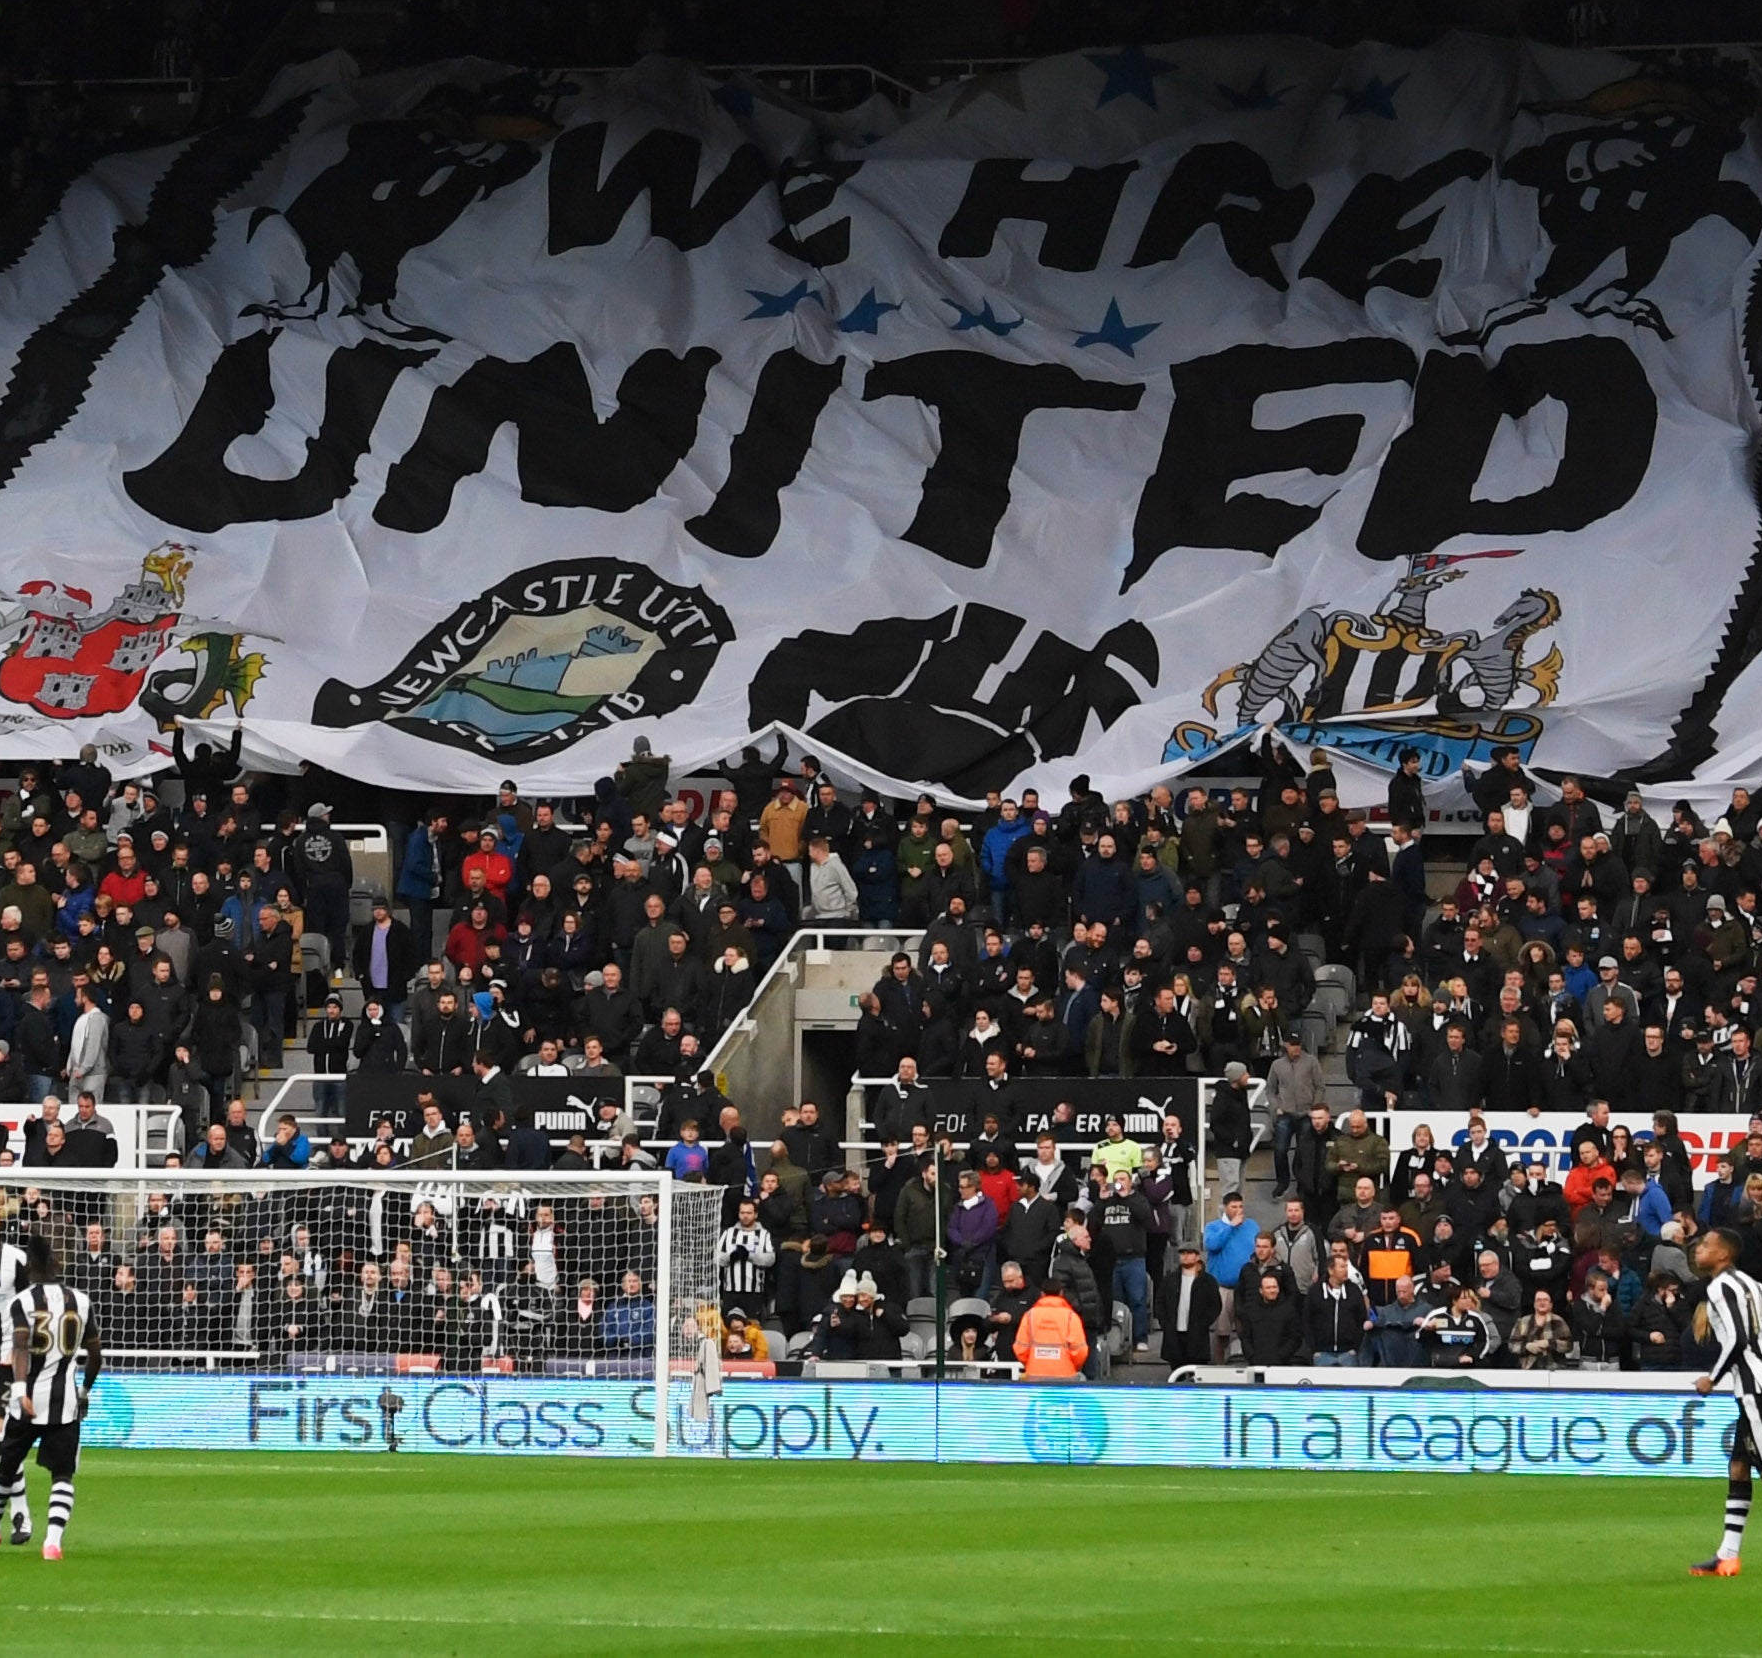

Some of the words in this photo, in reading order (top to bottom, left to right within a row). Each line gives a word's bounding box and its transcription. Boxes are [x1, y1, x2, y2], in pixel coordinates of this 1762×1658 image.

[124, 327, 1659, 594] UNITED
[534, 1112, 587, 1131] PUMA
[1026, 1114, 1101, 1133] FAER
[31, 1310, 84, 1353] 30
[249, 1379, 404, 1446] First
[423, 1381, 606, 1449] Class
[629, 1384, 884, 1460] Supply.
[1223, 1395, 1280, 1459] In
[1301, 1413, 1343, 1460] a
[1367, 1395, 1607, 1473] league
[1626, 1399, 1706, 1466] of
